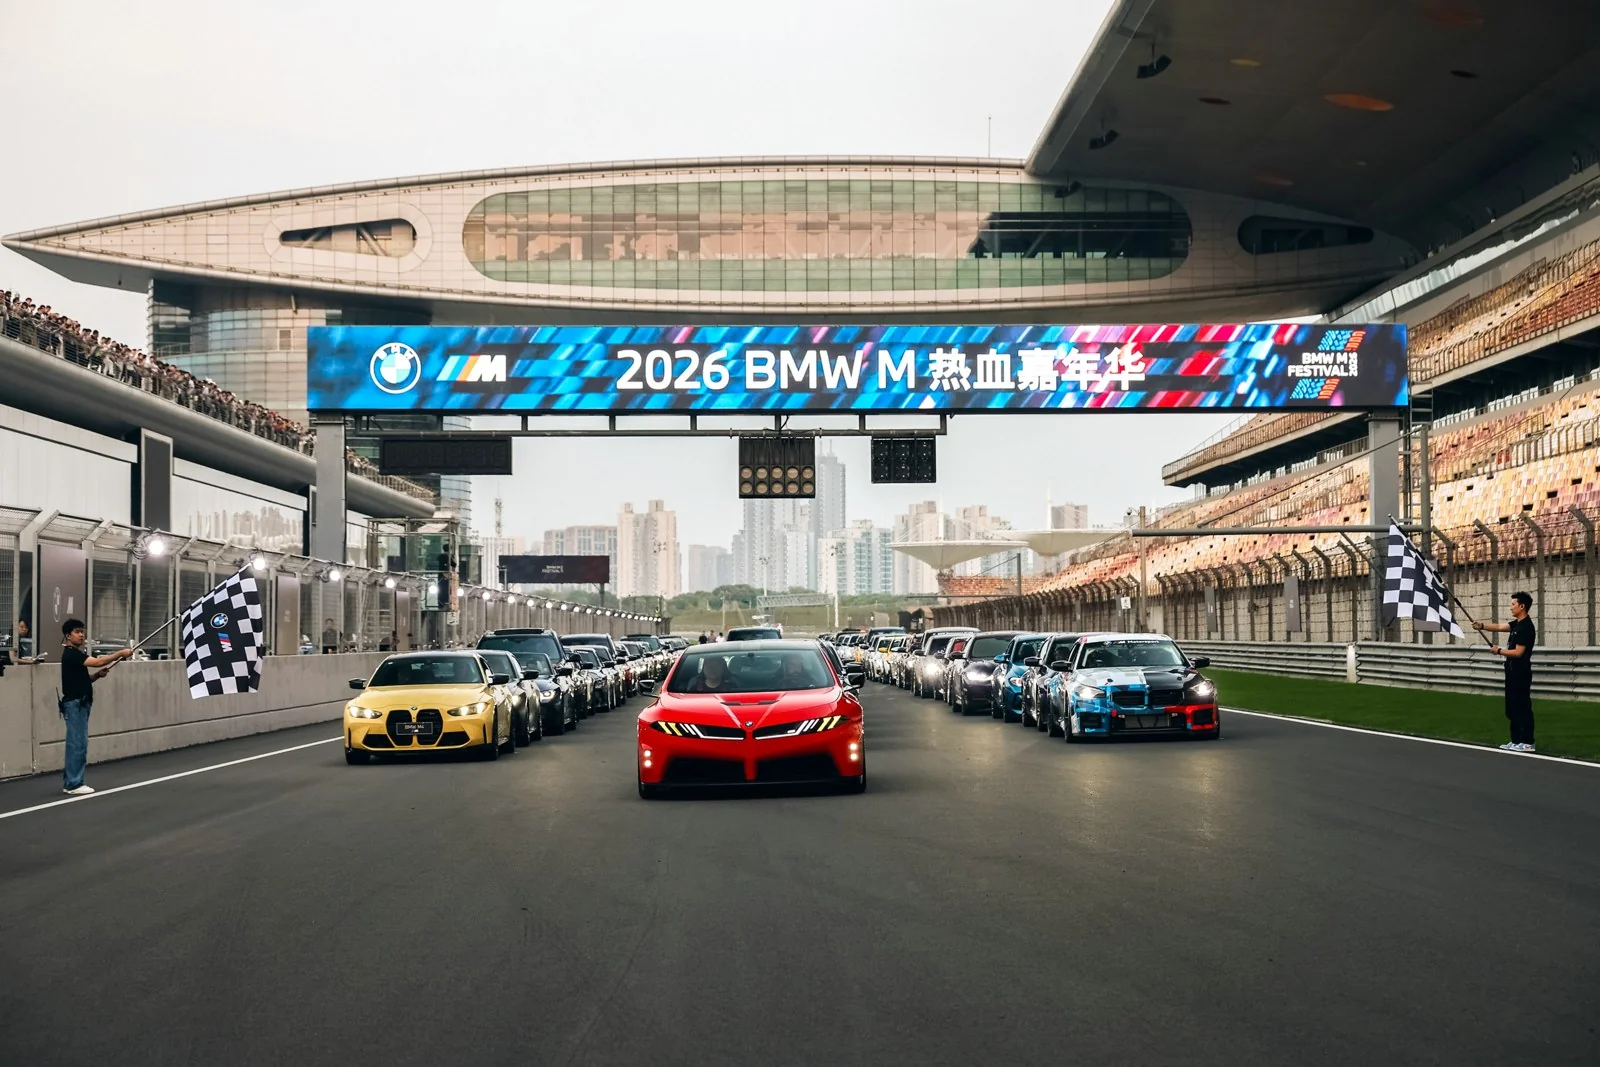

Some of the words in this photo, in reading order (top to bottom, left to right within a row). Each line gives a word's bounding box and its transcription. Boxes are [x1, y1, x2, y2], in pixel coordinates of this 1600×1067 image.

[464, 354, 507, 382] M
[1302, 352, 1334, 365] BMW
[1336, 352, 1348, 365] M
[616, 349, 730, 390] 2026
[745, 350, 863, 389] BMW
[878, 350, 915, 389] M
[928, 347, 1146, 391] 热血嘉年华
[1288, 365, 1348, 377] FESTIVAL
